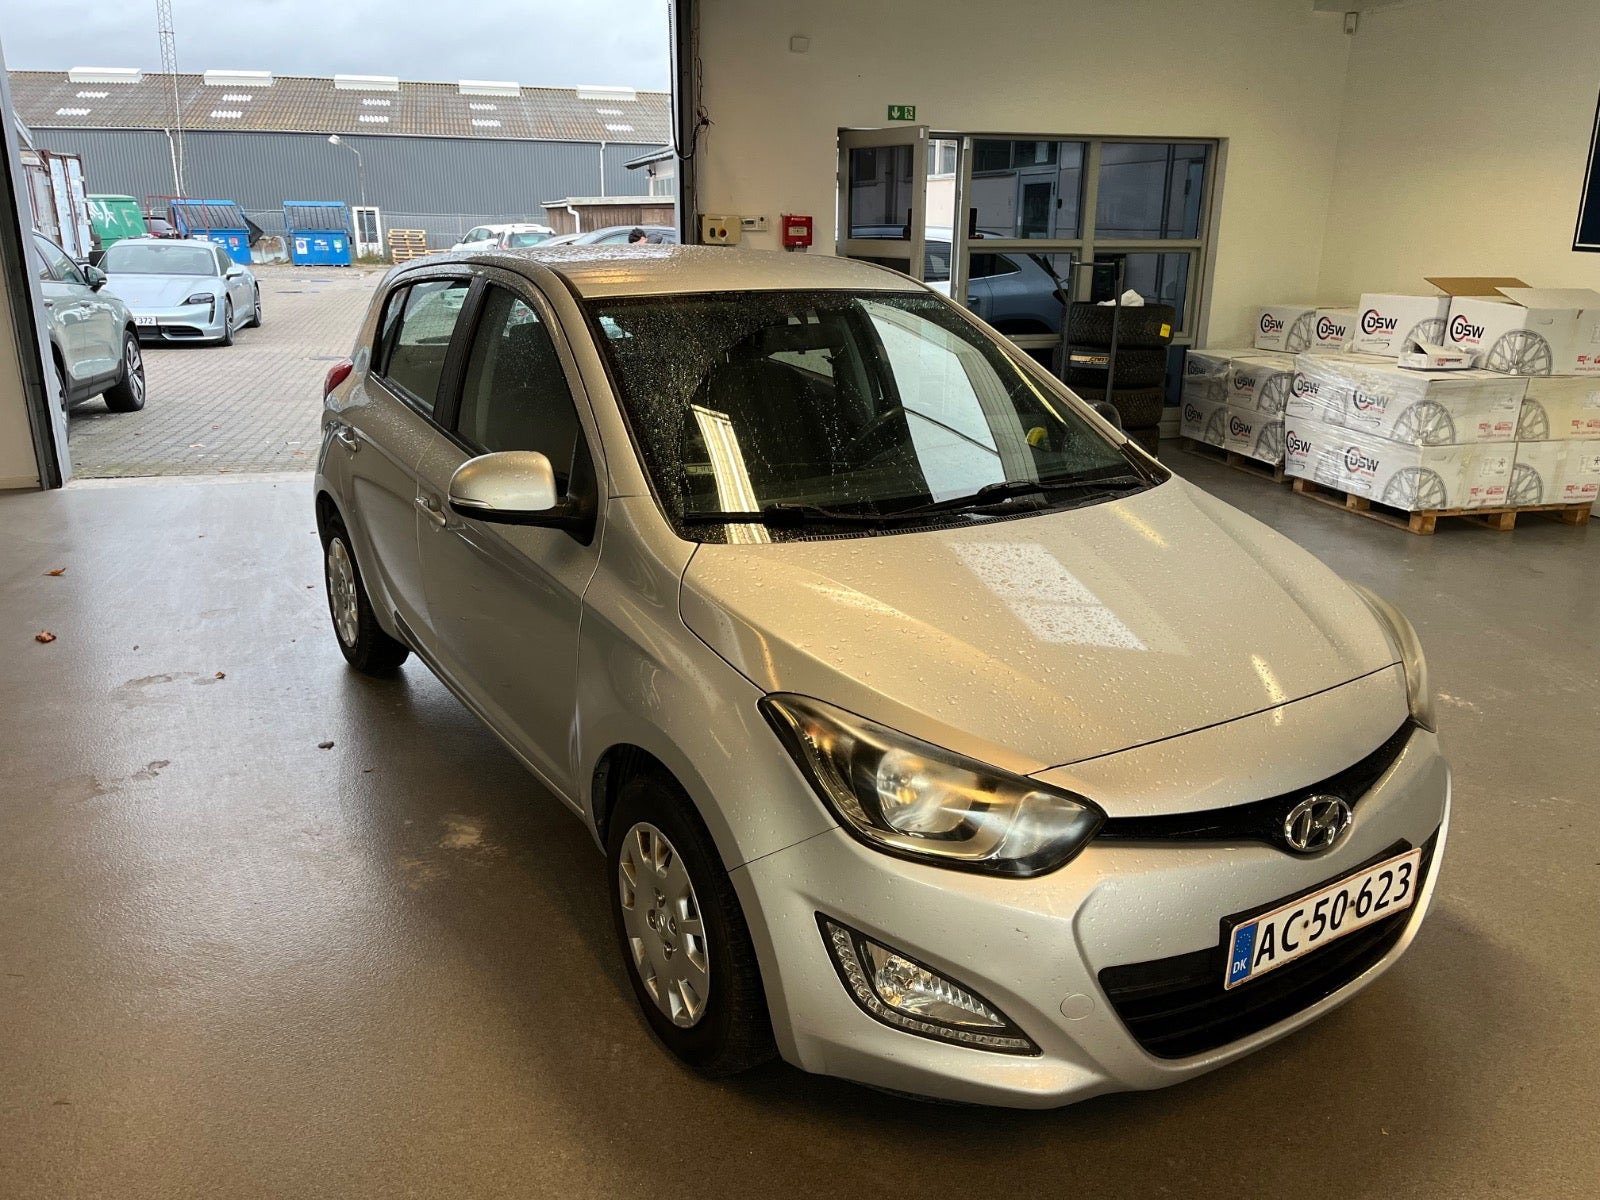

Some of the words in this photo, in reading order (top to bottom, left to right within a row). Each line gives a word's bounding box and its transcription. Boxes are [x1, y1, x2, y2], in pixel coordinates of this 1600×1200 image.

[1367, 316, 1398, 330] DSW
[1455, 323, 1485, 338] DSW
[1254, 909, 1304, 968] AC
[1309, 890, 1349, 942] 50
[1355, 862, 1412, 919] 623
[1232, 957, 1248, 974] DK
